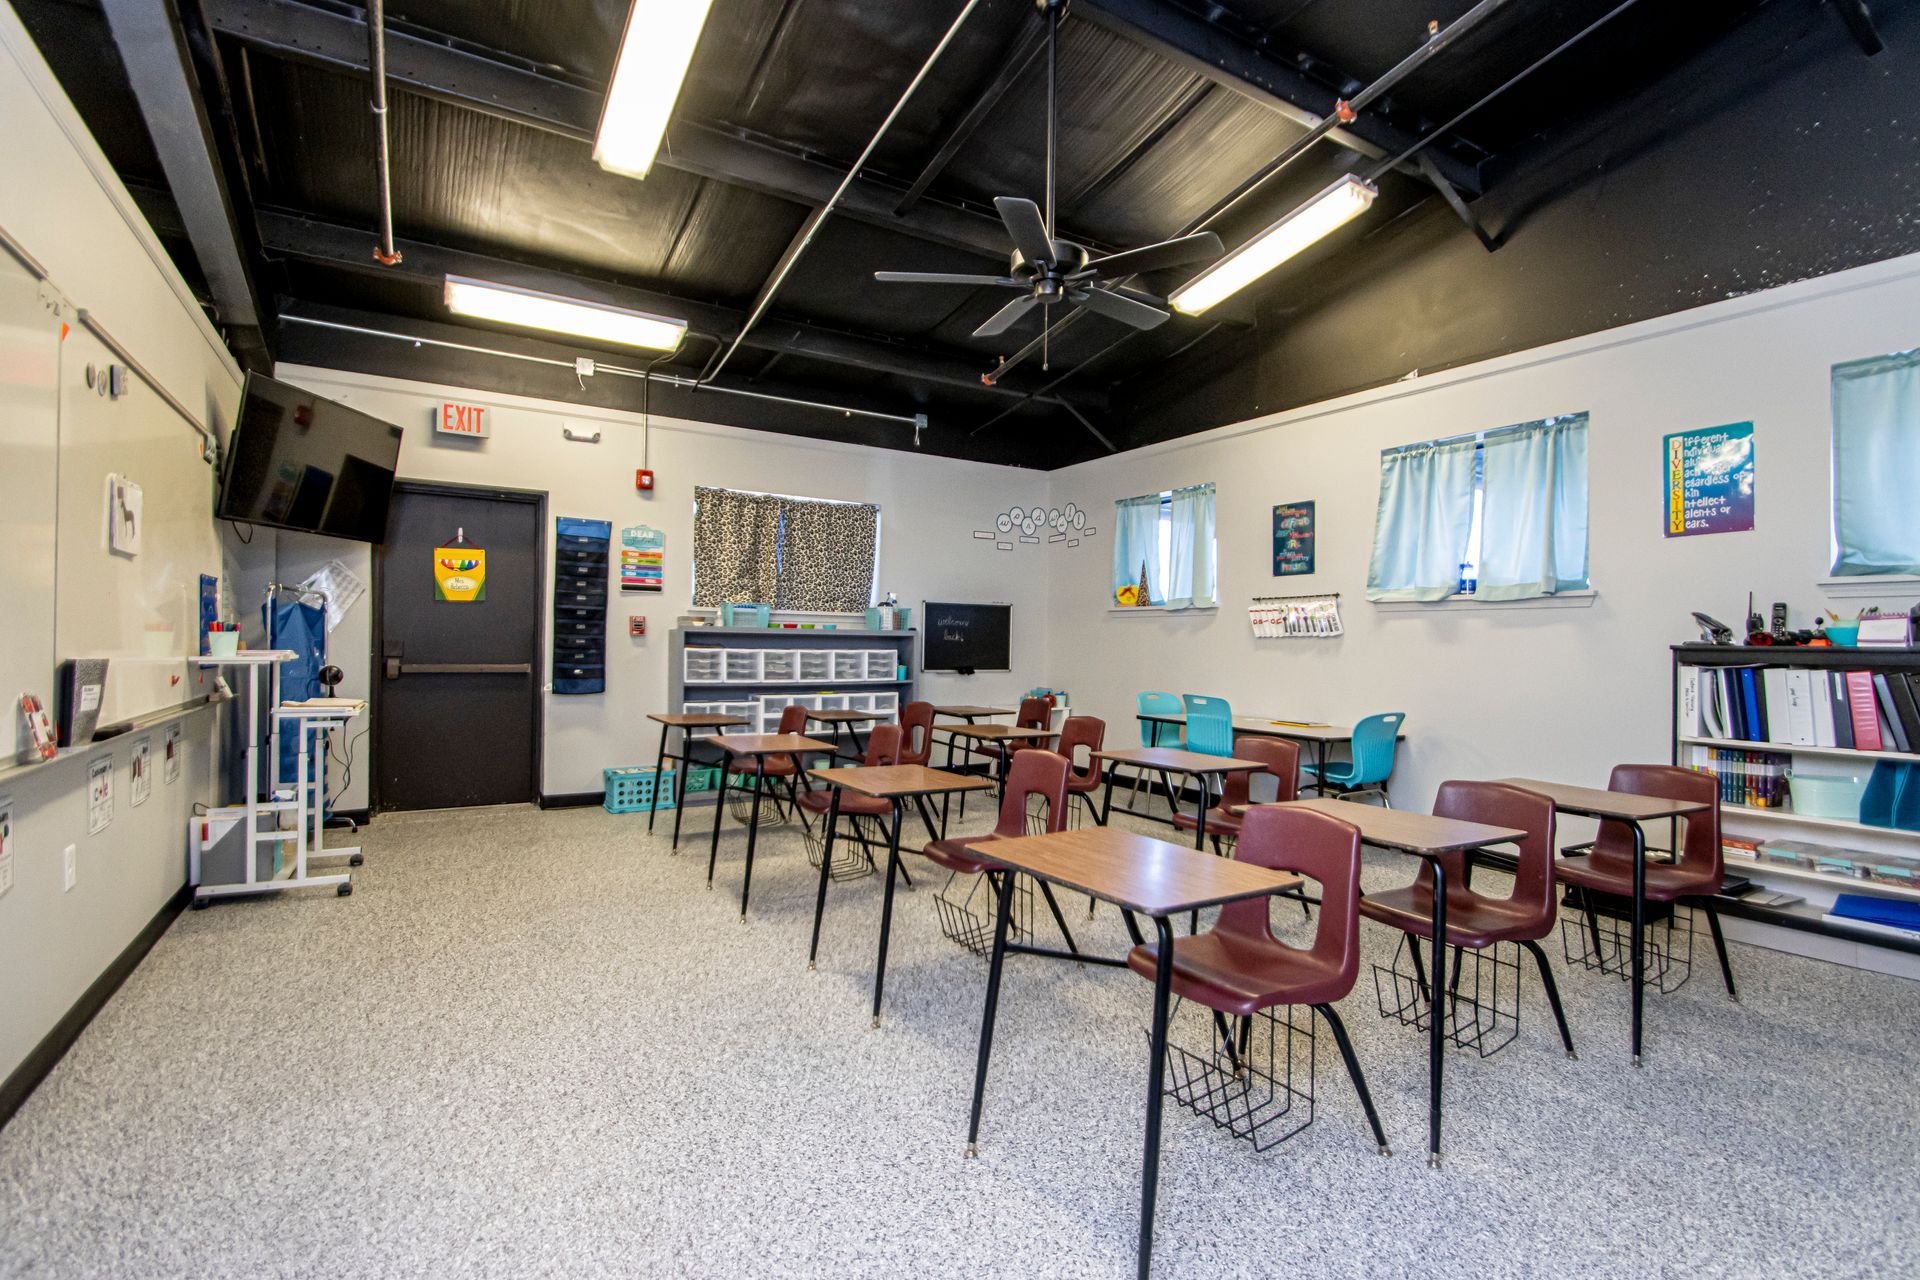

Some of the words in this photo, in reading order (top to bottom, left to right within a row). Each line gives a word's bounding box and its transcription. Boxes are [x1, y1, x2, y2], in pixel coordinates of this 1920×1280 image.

[443, 403, 485, 433] EXIT
[1684, 432, 1729, 446] ifferent
[1672, 439, 1682, 531] DIVERSITY
[1684, 488, 1700, 498] kin
[1684, 496, 1727, 508] ntellect
[1684, 507, 1717, 519] alents
[1719, 505, 1732, 515] or
[1684, 519, 1710, 529] ears.
